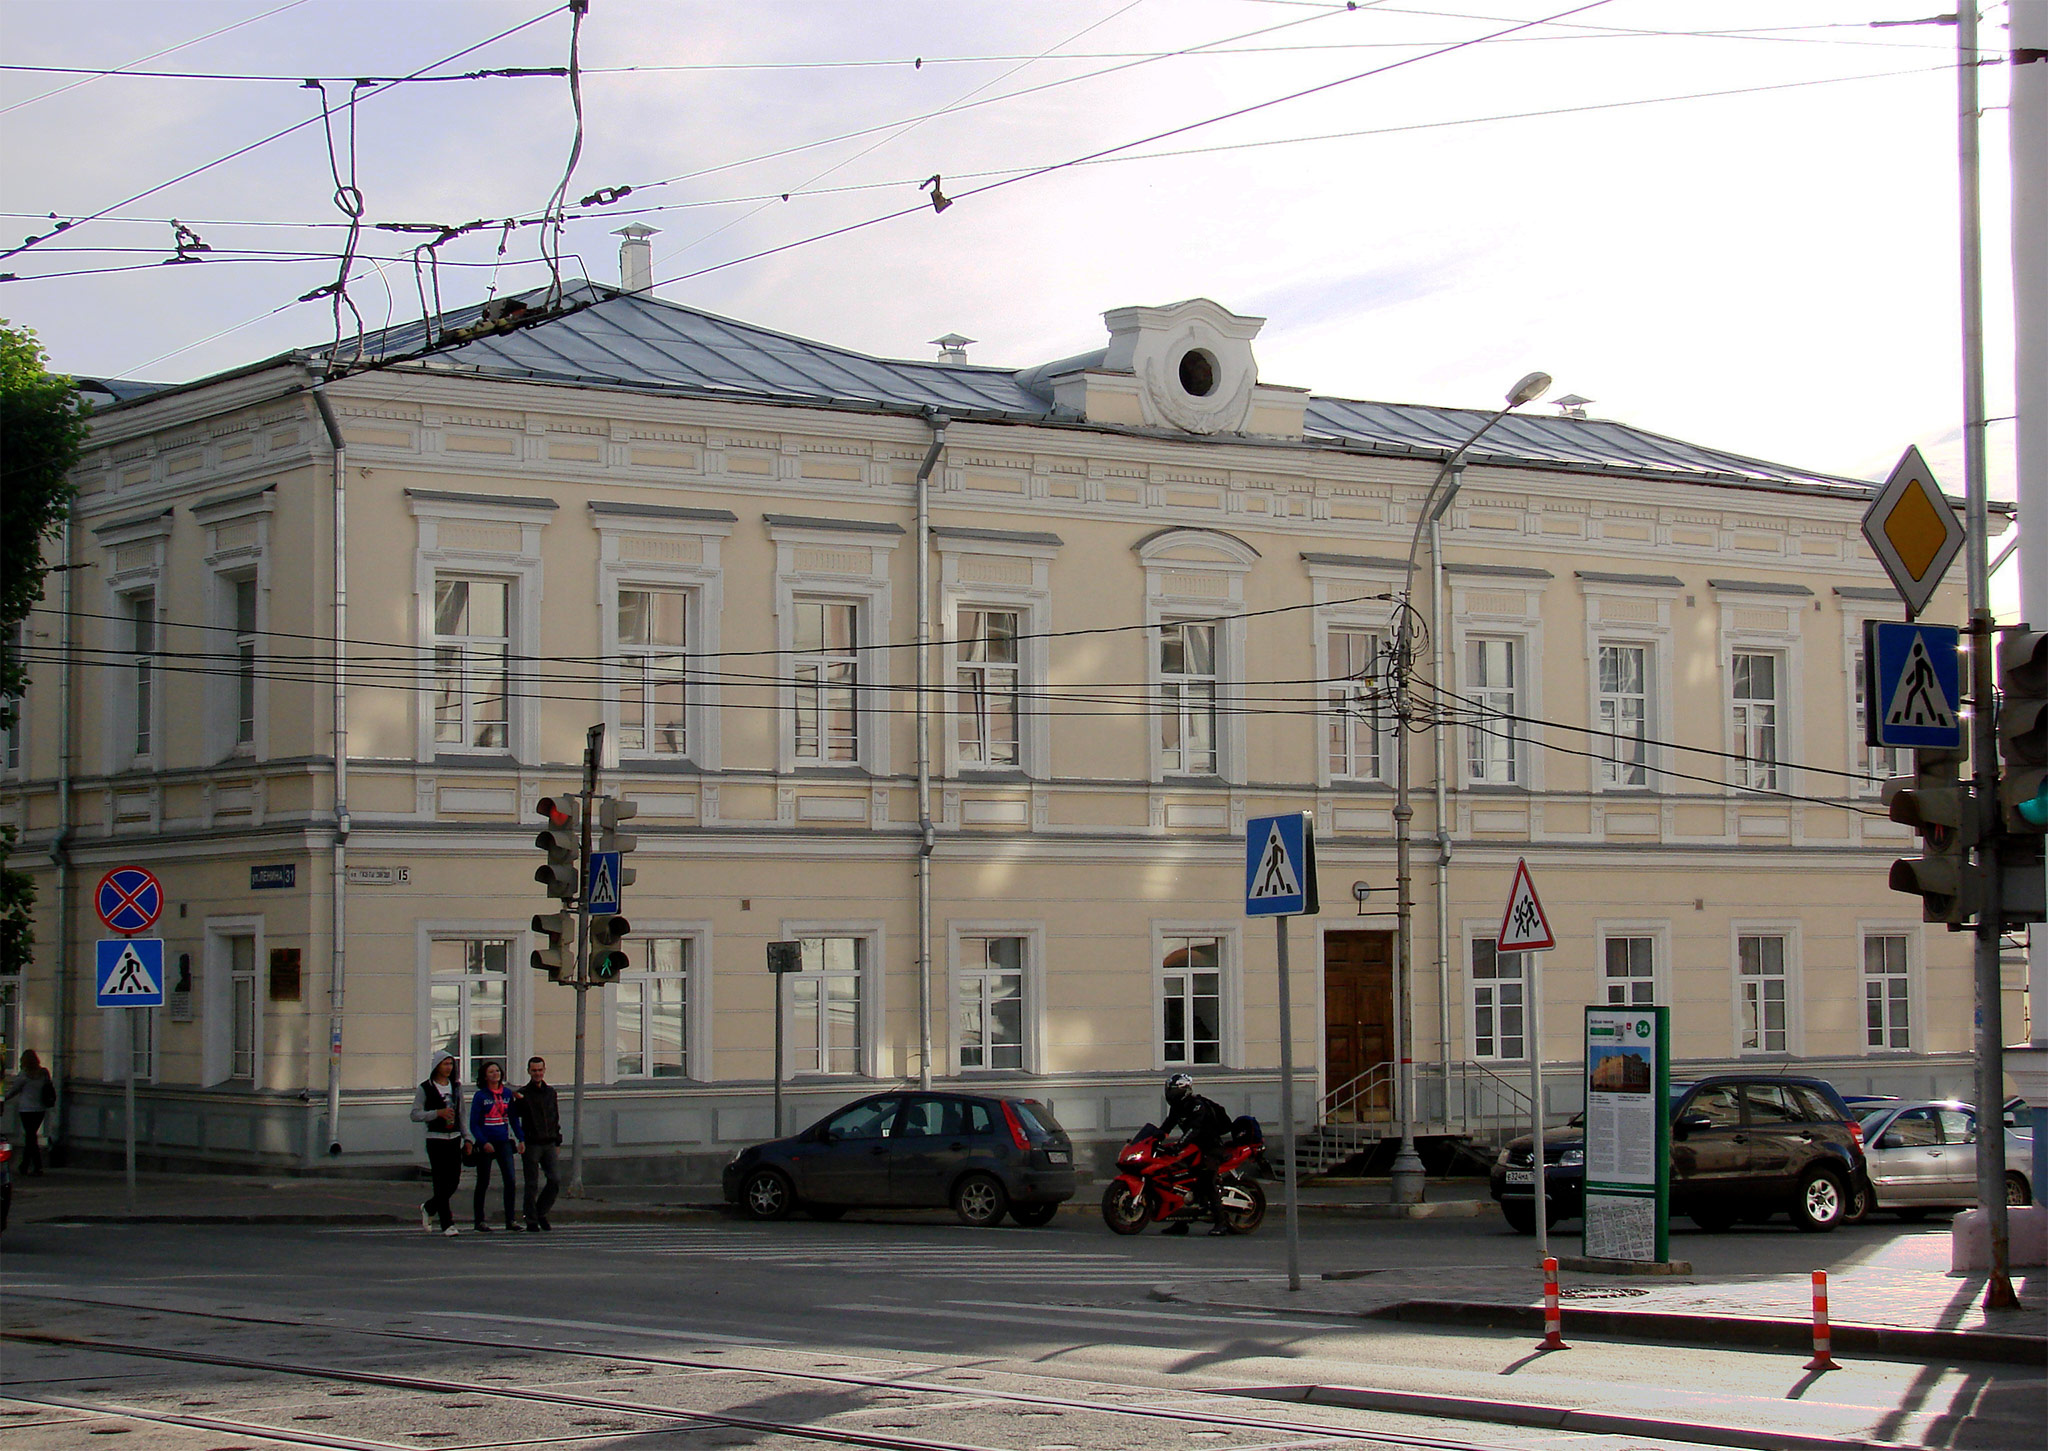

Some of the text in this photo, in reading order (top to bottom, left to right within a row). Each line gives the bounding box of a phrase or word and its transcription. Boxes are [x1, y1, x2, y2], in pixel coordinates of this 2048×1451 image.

[284, 869, 294, 883] 31
[398, 869, 408, 881] 15
[1637, 1024, 1648, 1034] 34
